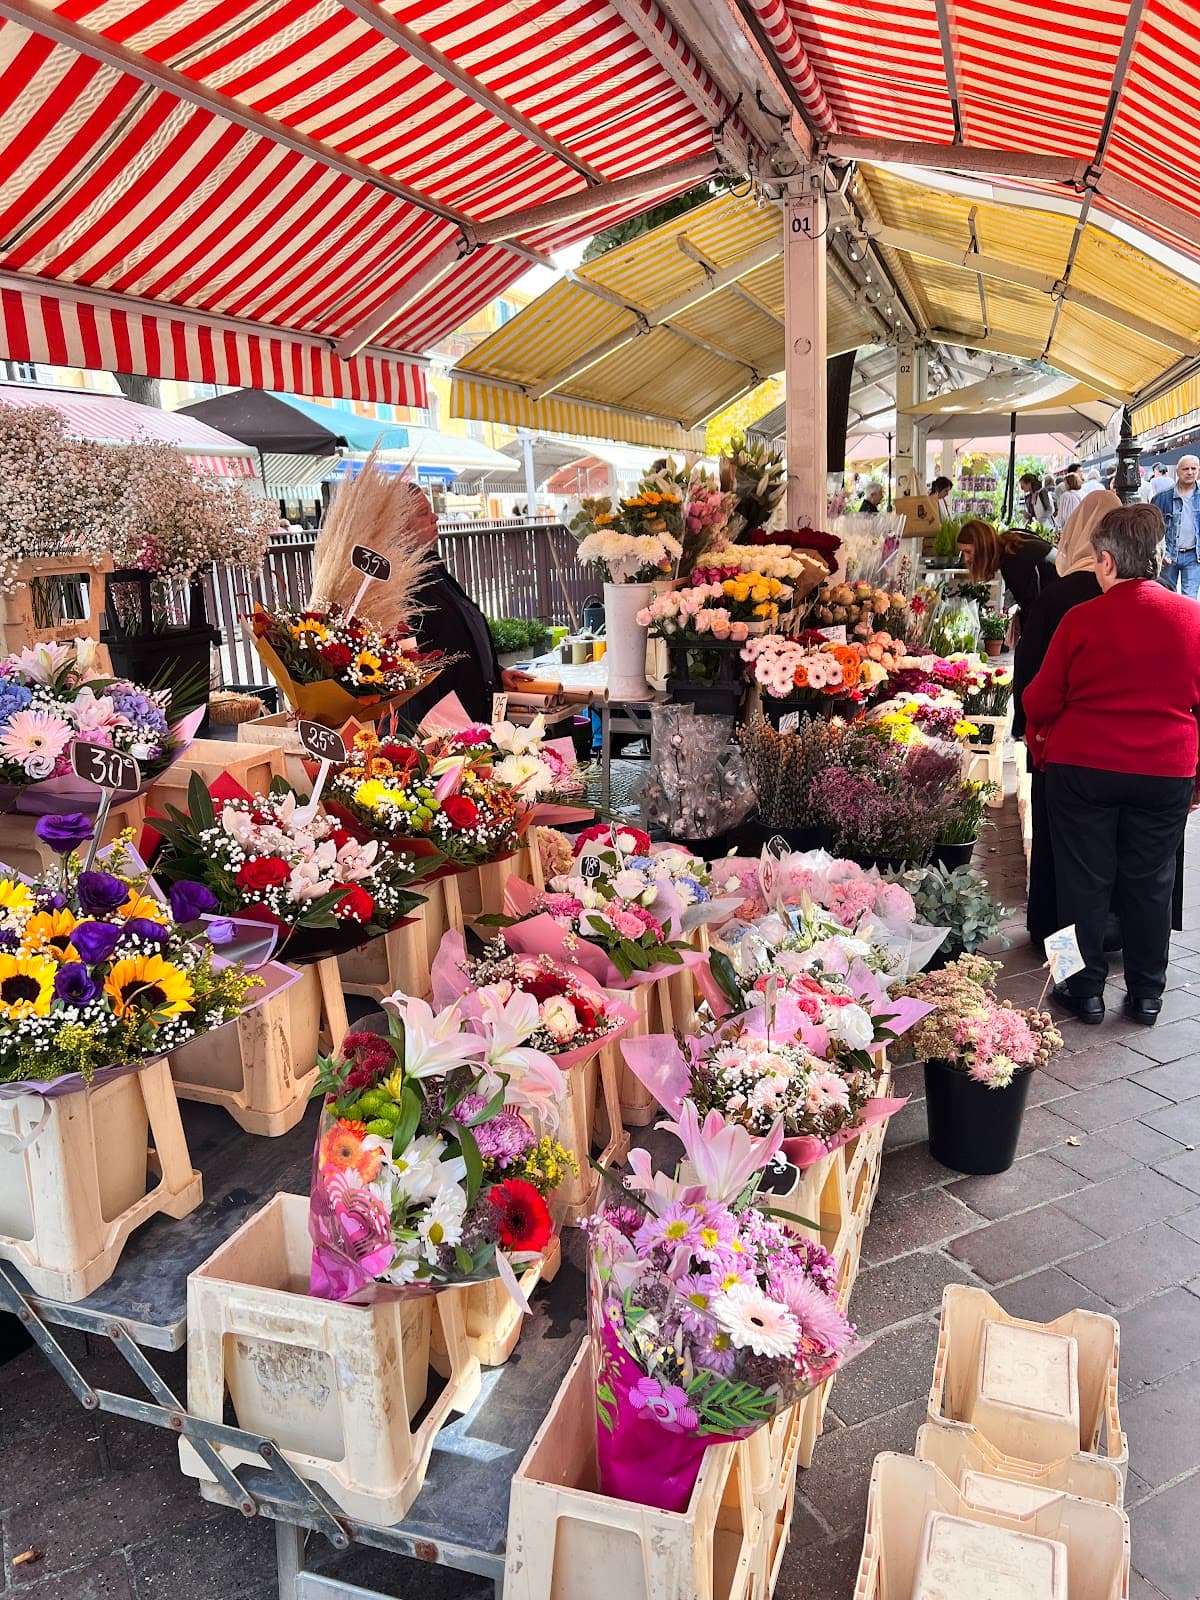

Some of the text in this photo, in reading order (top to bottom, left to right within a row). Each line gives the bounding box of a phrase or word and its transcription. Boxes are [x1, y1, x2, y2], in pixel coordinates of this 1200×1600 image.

[792, 217, 811, 233] 01
[900, 365, 911, 374] 02
[307, 727, 335, 752] 25€
[90, 748, 134, 787] 30€
